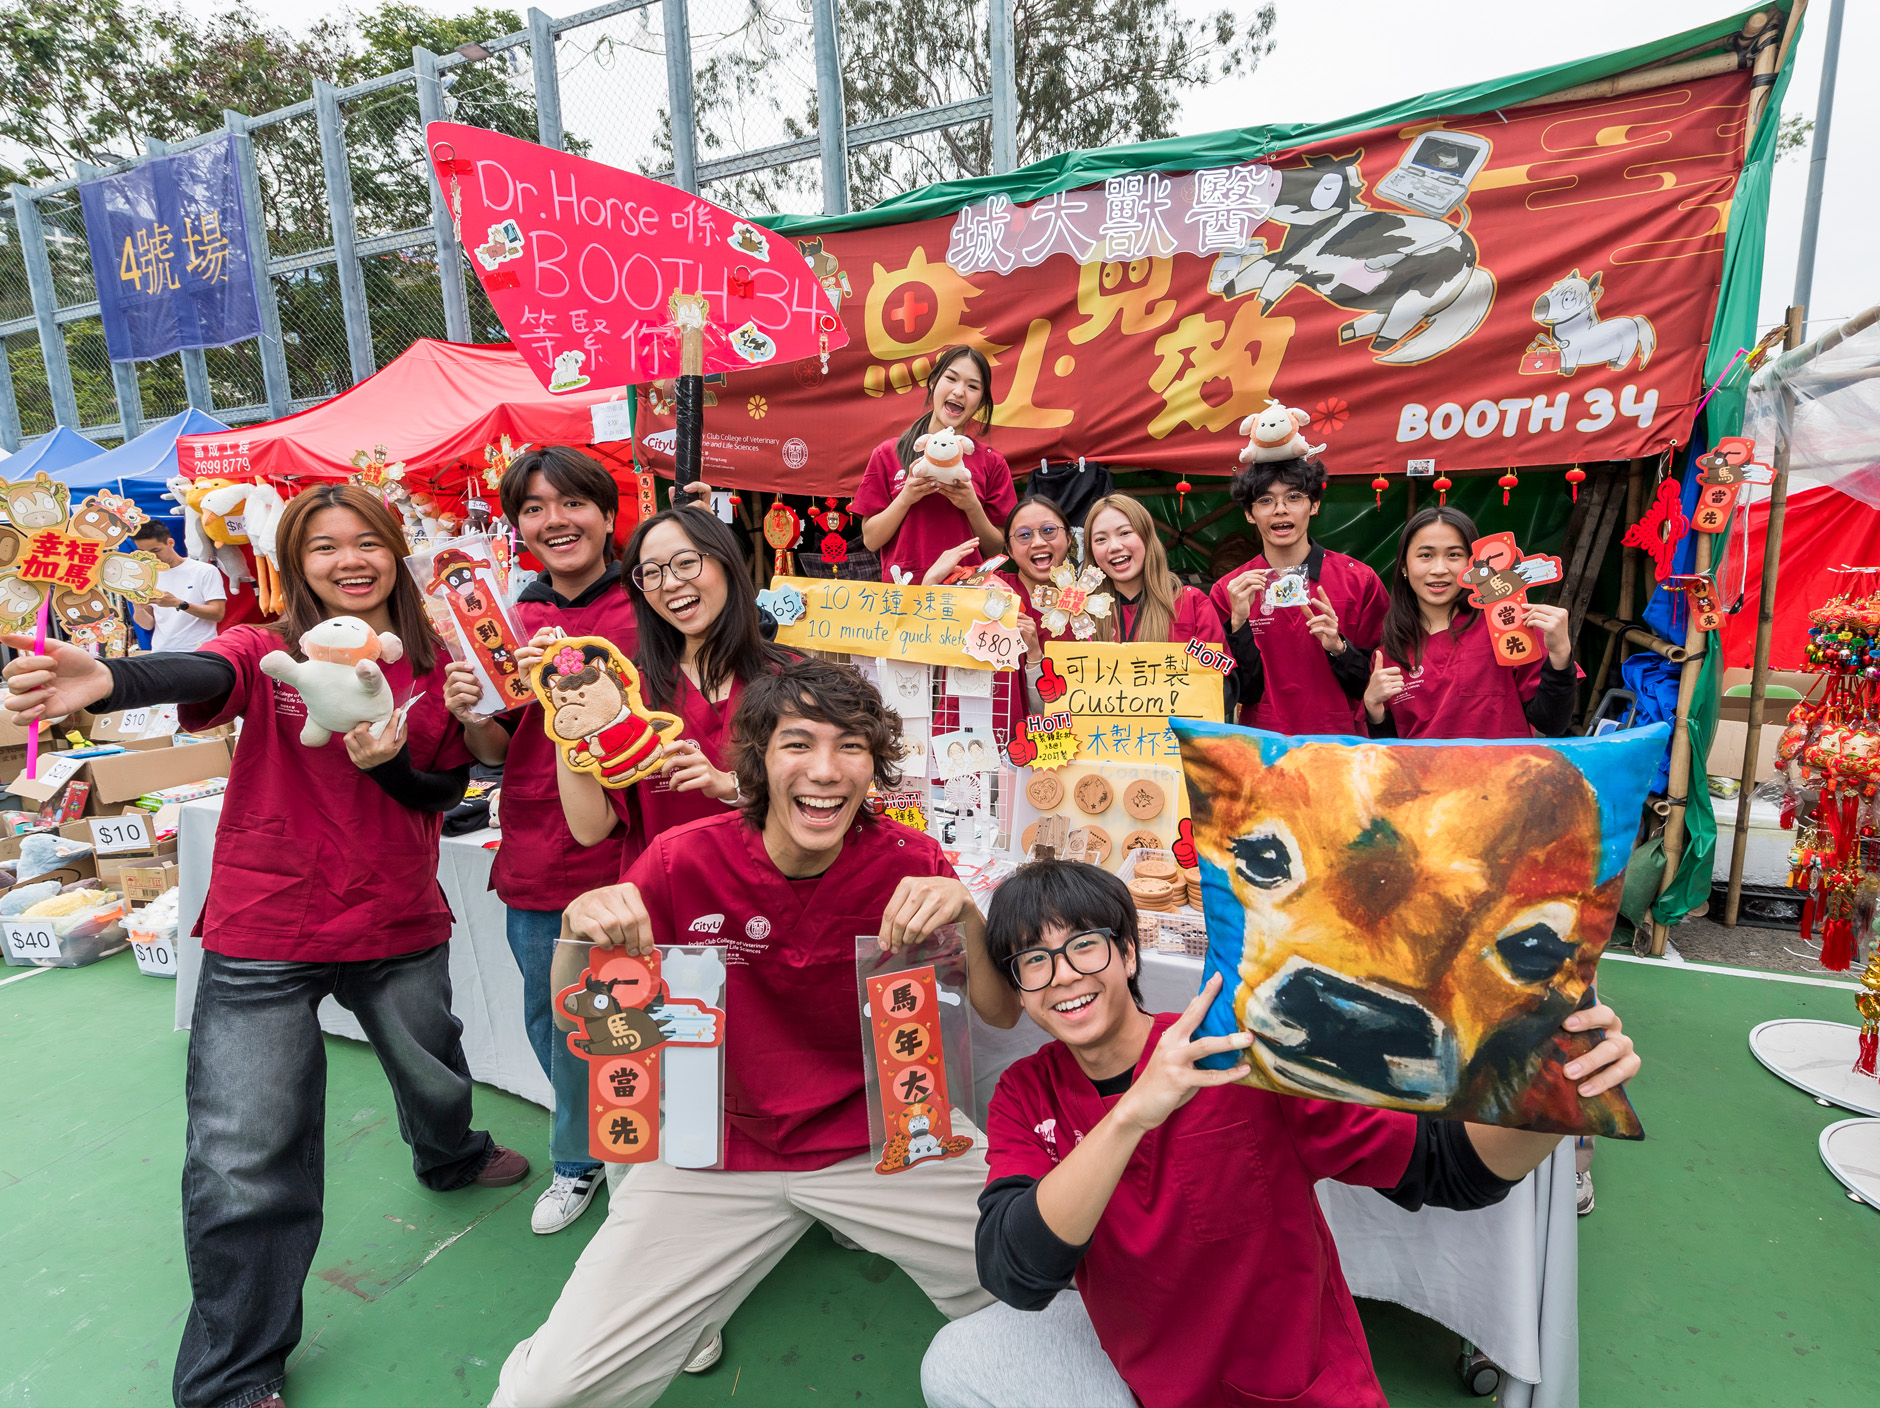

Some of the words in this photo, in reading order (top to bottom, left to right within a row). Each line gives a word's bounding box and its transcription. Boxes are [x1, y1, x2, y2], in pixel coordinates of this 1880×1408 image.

[950, 164, 1271, 271] 城大獸醫
[120, 210, 229, 295] 4號場
[529, 229, 729, 324] BOOTH
[747, 267, 829, 335] 34
[519, 305, 673, 376] 等緊你
[1396, 391, 1571, 443] BOOTH
[1575, 384, 1660, 434] 34
[194, 460, 221, 475] 2699
[222, 457, 251, 473] 8779
[31, 531, 100, 567] 幸福
[22, 555, 93, 591] 加馬
[820, 585, 850, 610] 10
[807, 619, 831, 639] 10
[839, 621, 889, 642] minute
[899, 624, 933, 655] quick
[975, 630, 1011, 657] $80
[1187, 639, 1234, 674] HOT!
[1066, 653, 1190, 688] 可以訂製
[1068, 688, 1180, 715] Custom!
[125, 713, 146, 727] $10
[1028, 712, 1071, 732] HOT!
[884, 793, 920, 809] HOT!
[99, 824, 140, 845] $10
[12, 929, 50, 951] $40
[693, 921, 722, 933] CityU
[135, 942, 169, 965] $10
[716, 937, 736, 946] College
[742, 941, 769, 950] Veterinary
